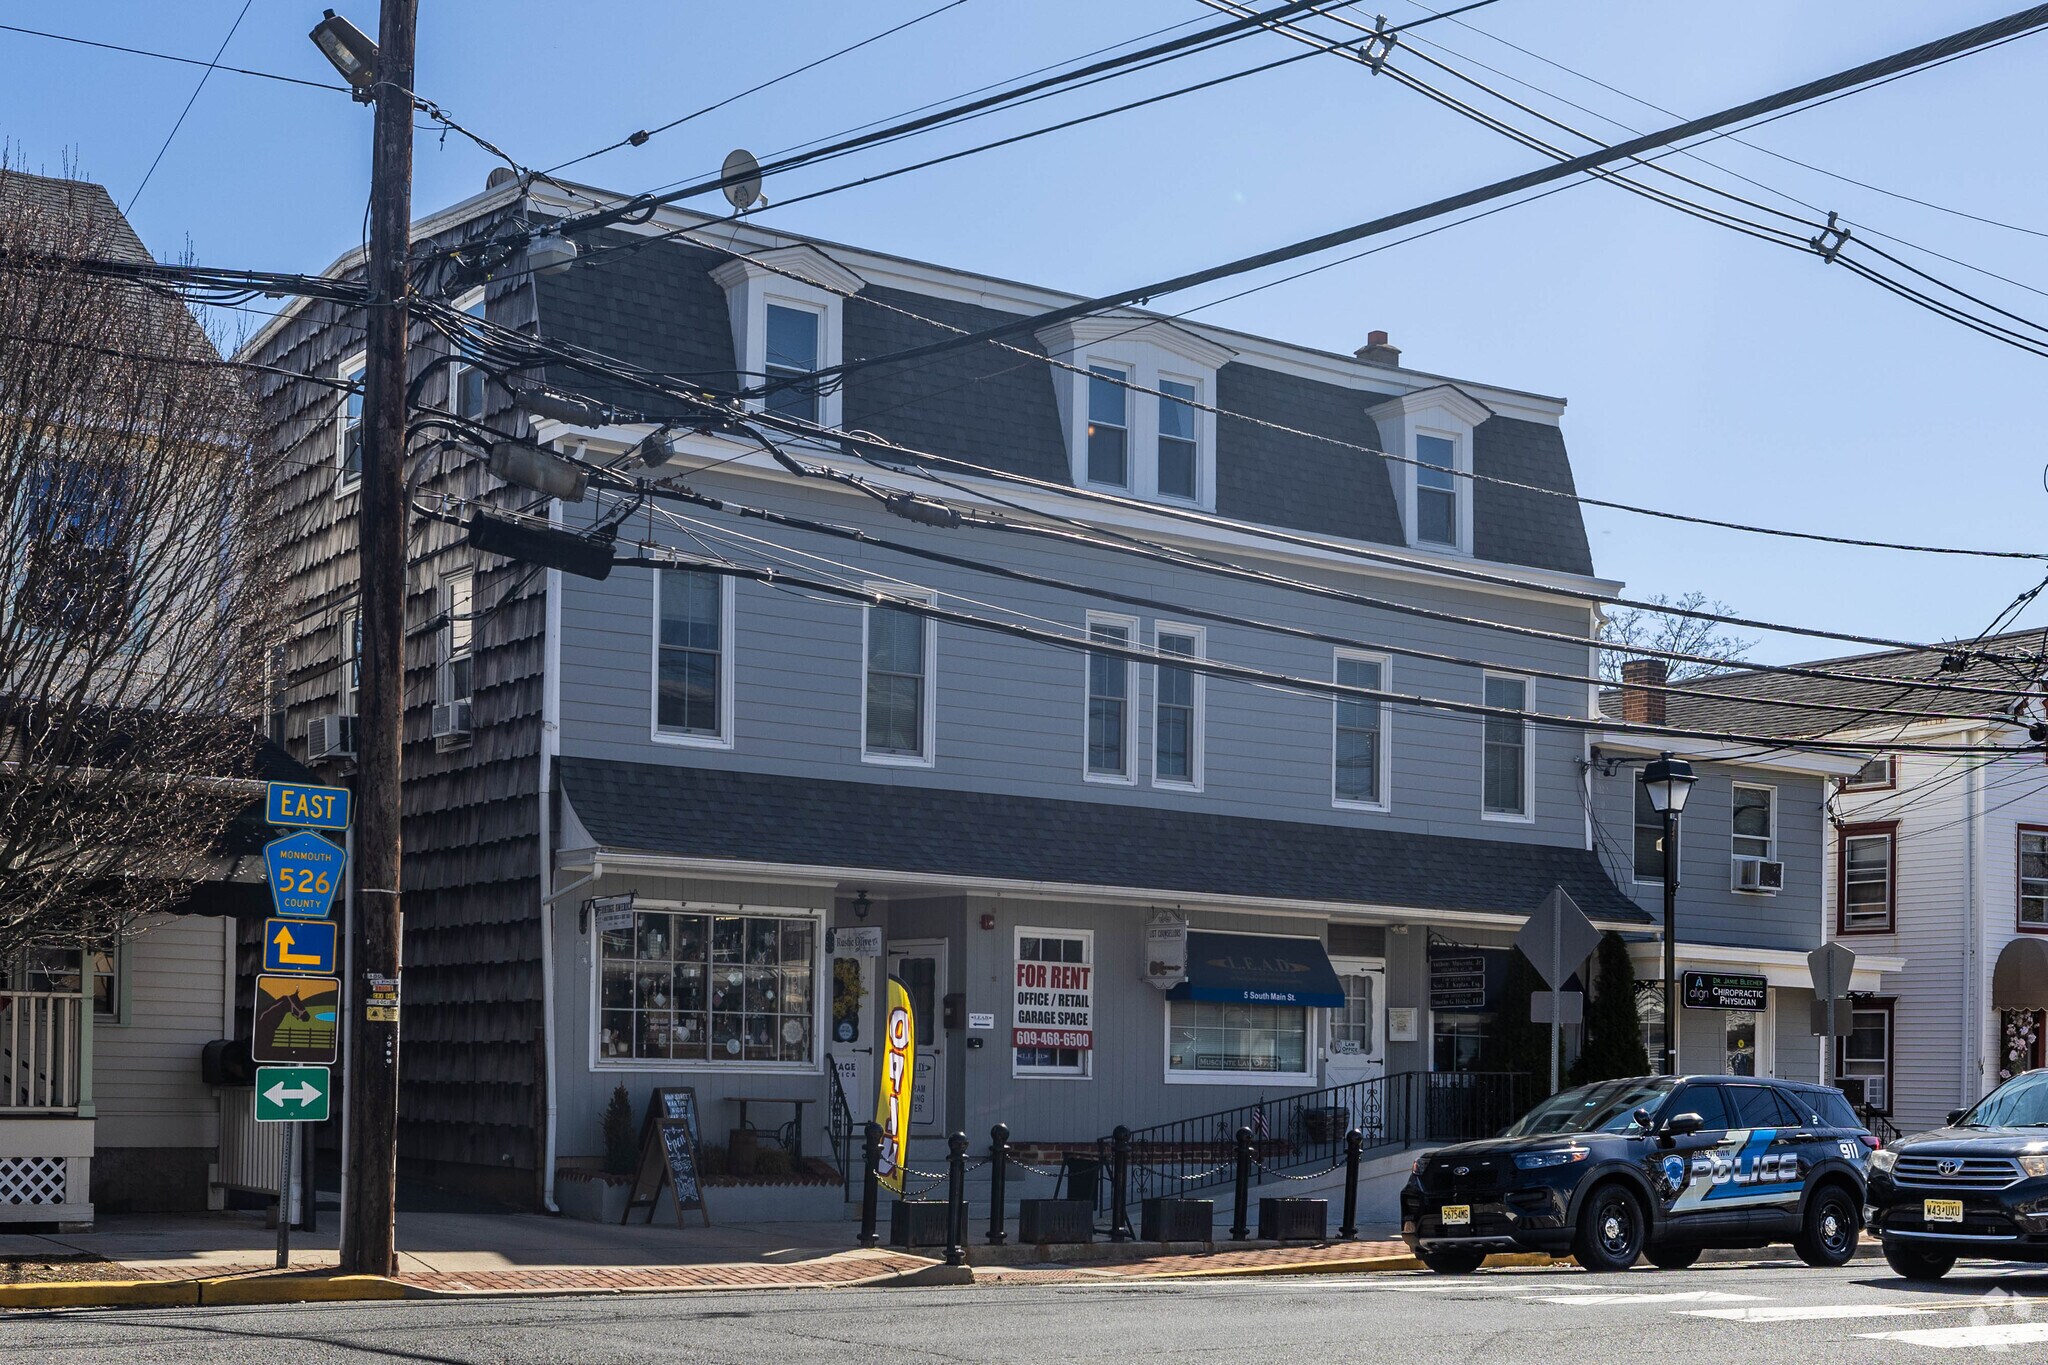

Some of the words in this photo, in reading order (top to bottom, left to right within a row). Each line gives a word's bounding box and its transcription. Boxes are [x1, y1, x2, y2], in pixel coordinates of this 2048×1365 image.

[281, 790, 336, 819] EAST
[280, 850, 332, 862] MONMOUTH
[280, 868, 331, 894] 526
[284, 898, 322, 909] COUNTY
[1017, 963, 1047, 988] FOR
[1051, 966, 1091, 990] RENT
[1018, 991, 1049, 1007] OFFICE
[1051, 993, 1056, 1007] /
[1058, 993, 1089, 1008] RETAIL
[1244, 991, 1248, 999] 5
[1249, 991, 1269, 1000] South
[1270, 992, 1286, 1001] Main
[1287, 993, 1296, 1001] St.
[1690, 986, 1709, 1001] align
[1712, 987, 1764, 998] CHIROPRACTIC
[1720, 996, 1757, 1006] PHYSICIAN
[1018, 1010, 1056, 1025] GARAGE
[1057, 1011, 1088, 1026] SPACE
[1016, 1030, 1090, 1047] 609-468-6500
[1812, 1115, 1818, 1125] 2
[664, 1133, 686, 1153] Open
[1839, 1143, 1859, 1160] 911
[1689, 1152, 1798, 1187] POLICE
